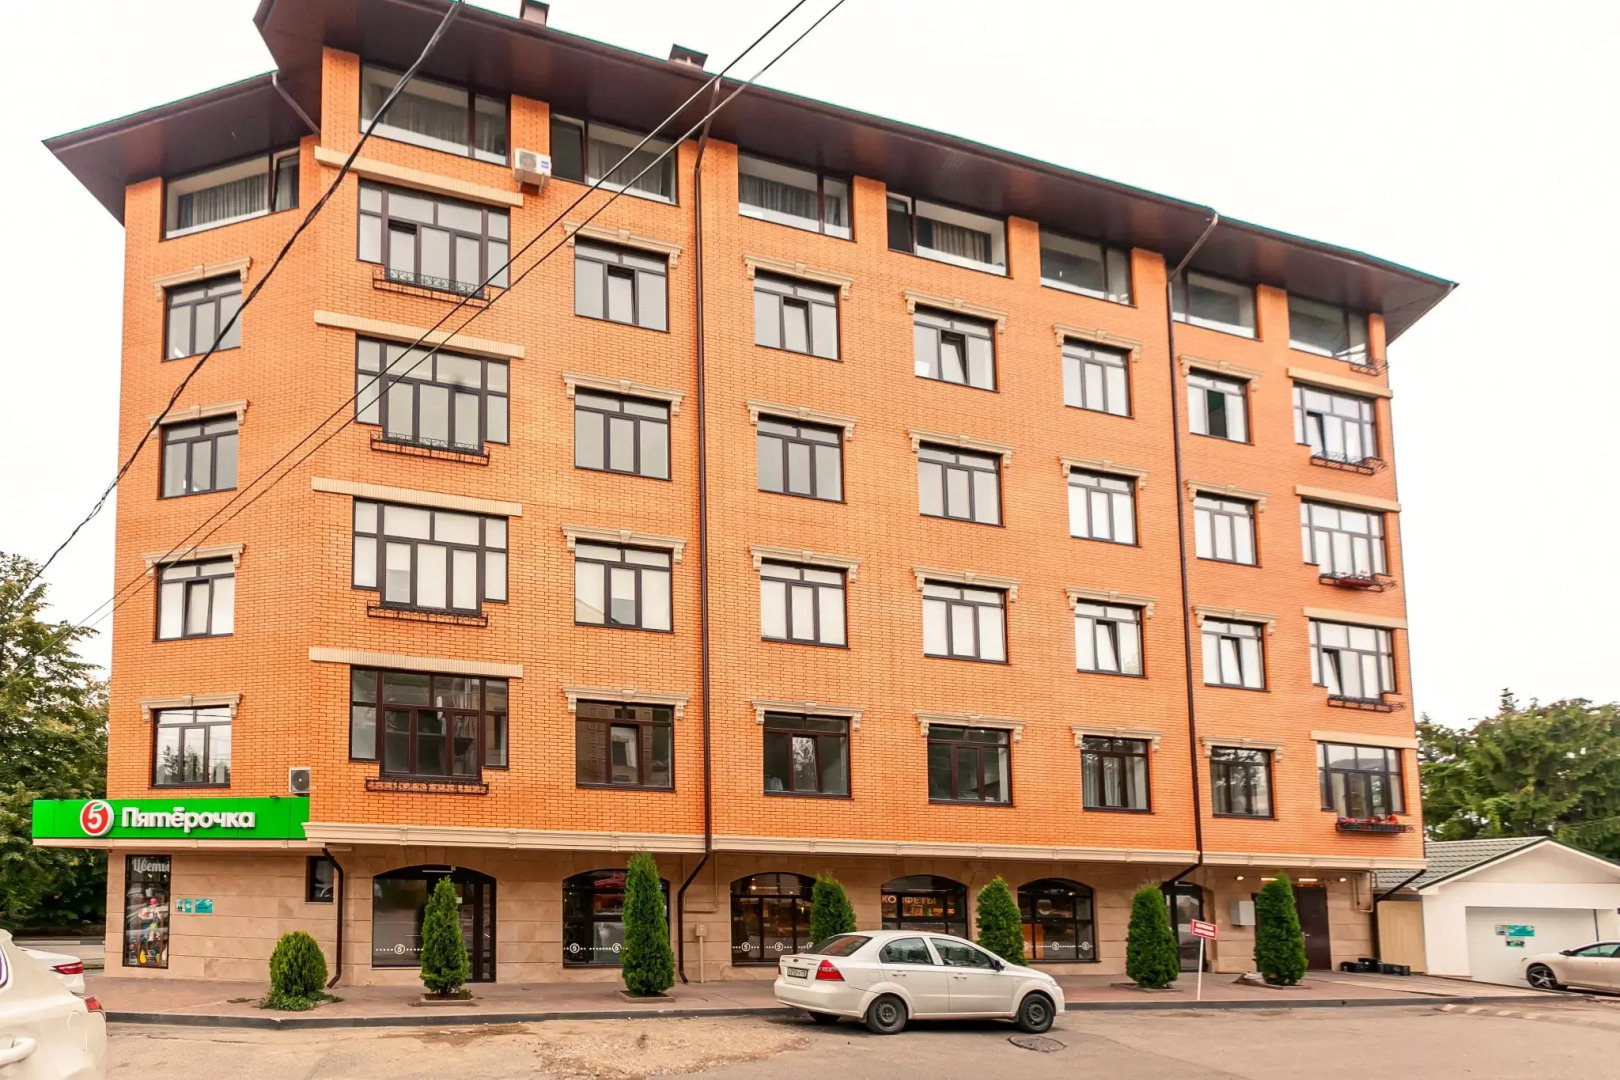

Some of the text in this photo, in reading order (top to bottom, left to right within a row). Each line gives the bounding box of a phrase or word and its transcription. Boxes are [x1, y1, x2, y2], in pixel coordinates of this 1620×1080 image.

[87, 804, 256, 833] 5 Пятёрочка
[132, 858, 170, 873] Цветы
[881, 894, 936, 905] КОФЕТЫ
